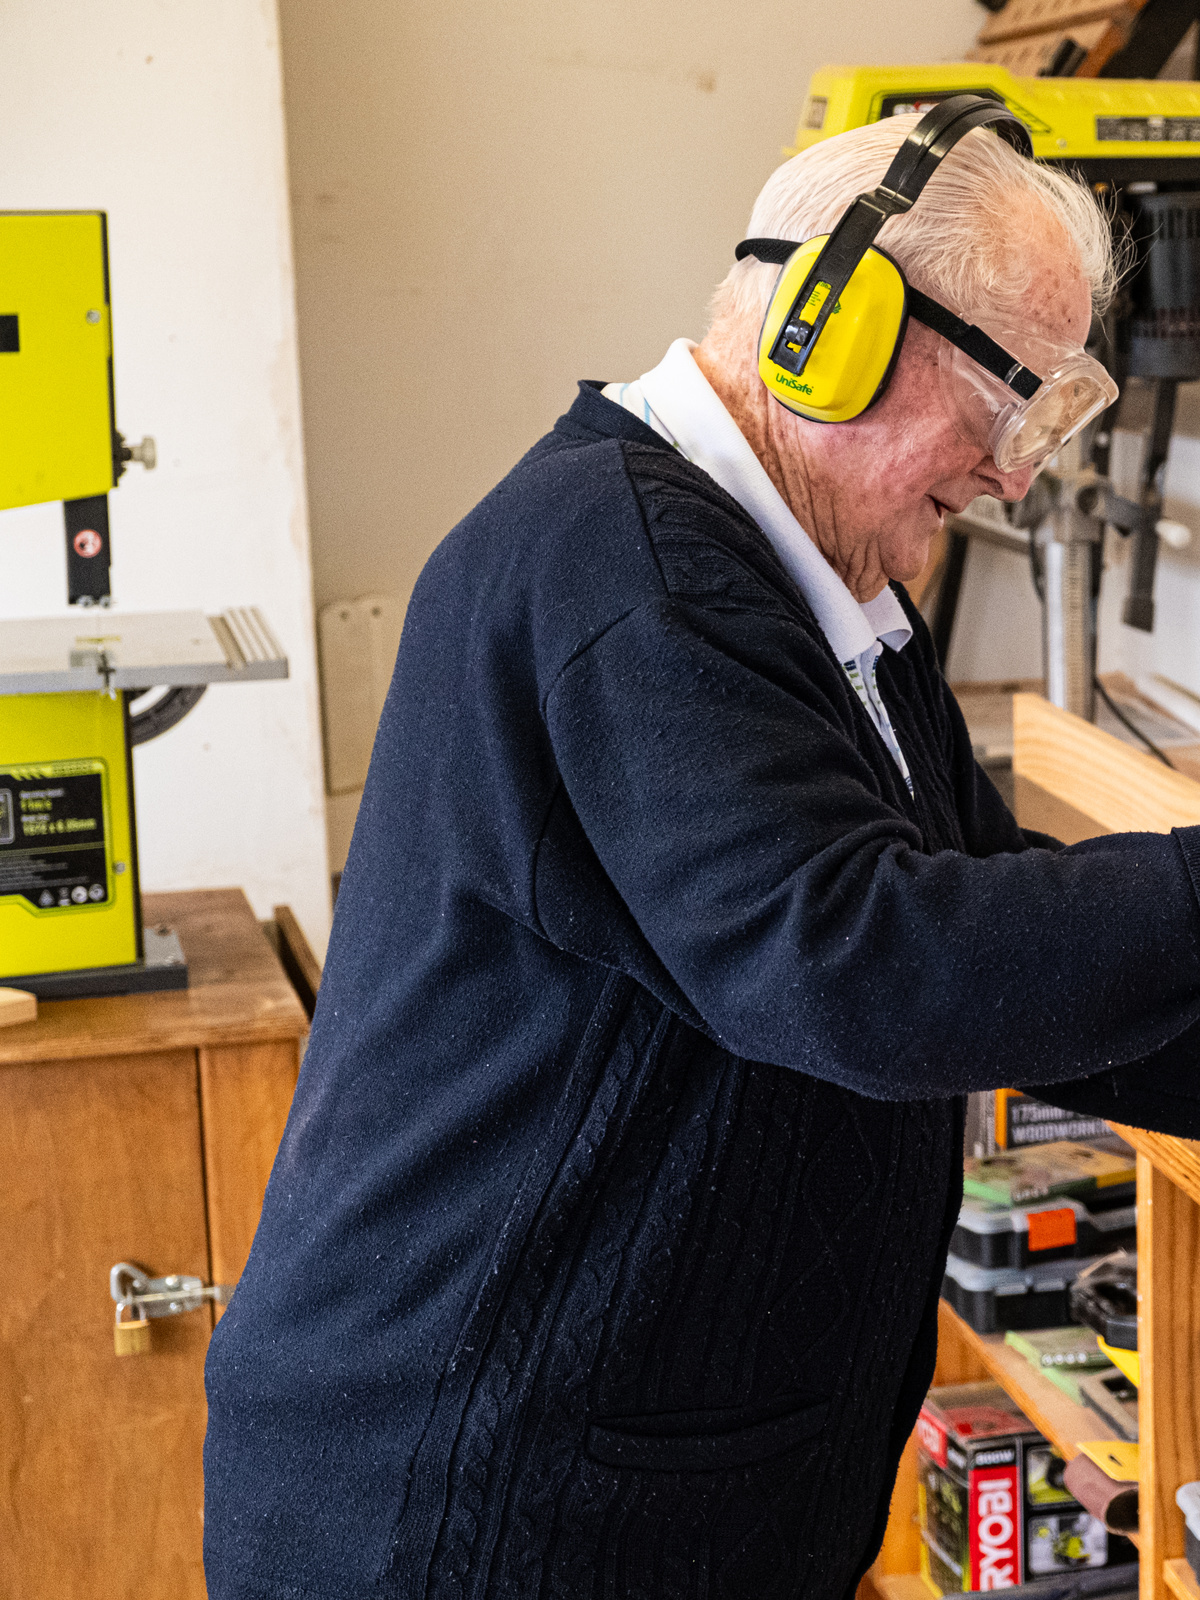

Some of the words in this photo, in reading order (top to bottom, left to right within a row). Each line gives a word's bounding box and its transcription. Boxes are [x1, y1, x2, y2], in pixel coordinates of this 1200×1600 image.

[776, 373, 812, 396] UniSafe
[1012, 1119, 1111, 1144] WOODWORKIN
[978, 1478, 1014, 1592] RYOBI
